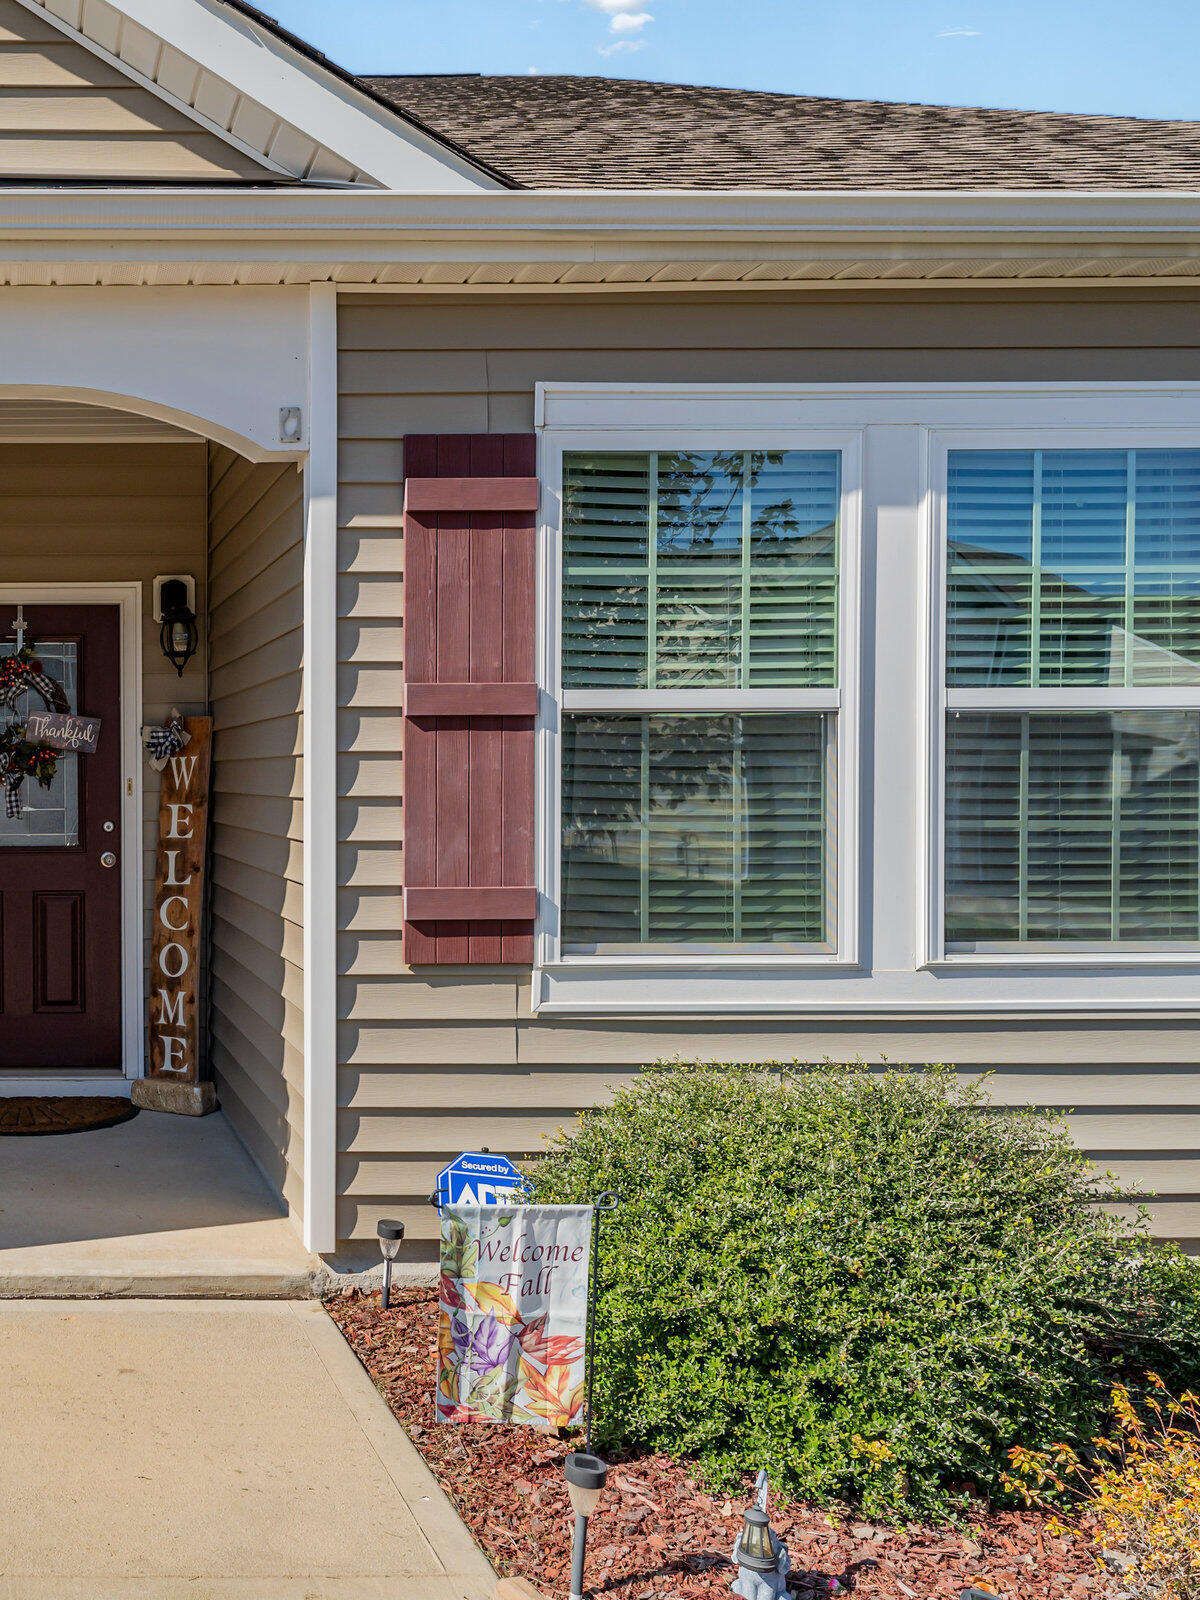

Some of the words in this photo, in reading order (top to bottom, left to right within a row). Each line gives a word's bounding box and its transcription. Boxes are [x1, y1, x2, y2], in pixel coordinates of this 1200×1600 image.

[28, 714, 95, 748] Thankful
[159, 755, 198, 1073] WELCOME
[461, 1161, 497, 1172] Secured
[498, 1164, 509, 1174] by
[471, 1233, 584, 1262] Welcome
[498, 1265, 559, 1297] Fall
